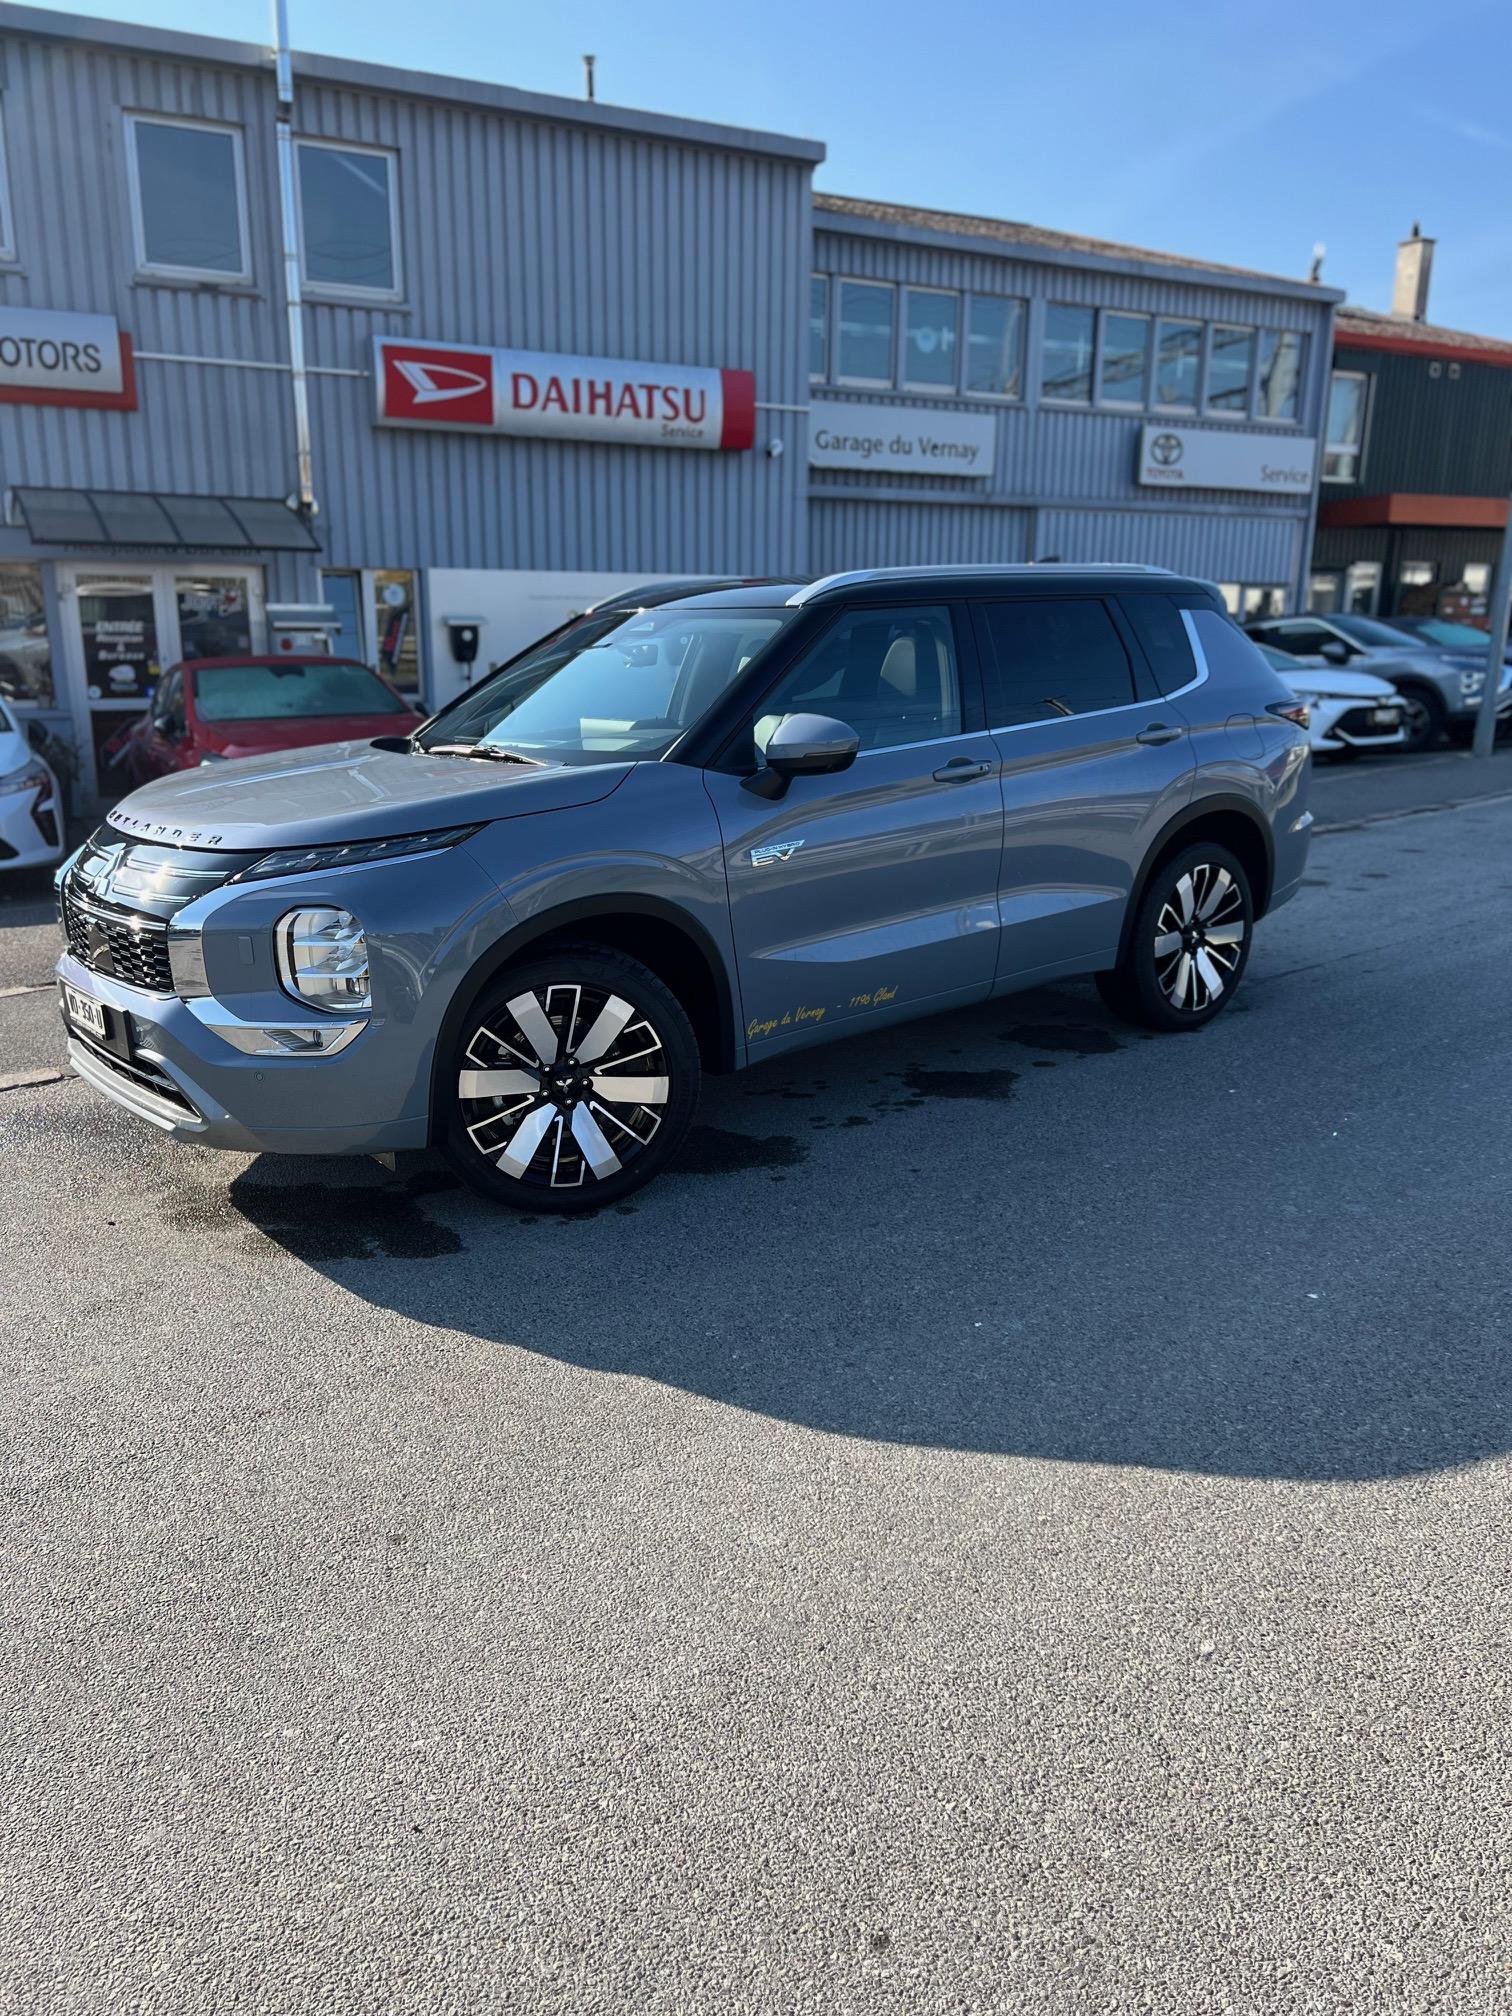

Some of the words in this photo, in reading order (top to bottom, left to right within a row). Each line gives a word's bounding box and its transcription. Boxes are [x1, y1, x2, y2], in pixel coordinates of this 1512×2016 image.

[511, 372, 706, 424] DAIHATSU
[661, 423, 704, 439] Service
[815, 429, 884, 459] Garage
[889, 434, 913, 456] du
[918, 436, 979, 465] Vernay
[1146, 466, 1185, 480] TOYOTA
[1261, 464, 1309, 484] Service
[109, 810, 223, 845] OUTLANDER
[751, 848, 795, 867] EV
[748, 1018, 777, 1039] Garage
[781, 1011, 791, 1025] du
[795, 1006, 825, 1021] Vernay
[849, 994, 871, 1008] 1196
